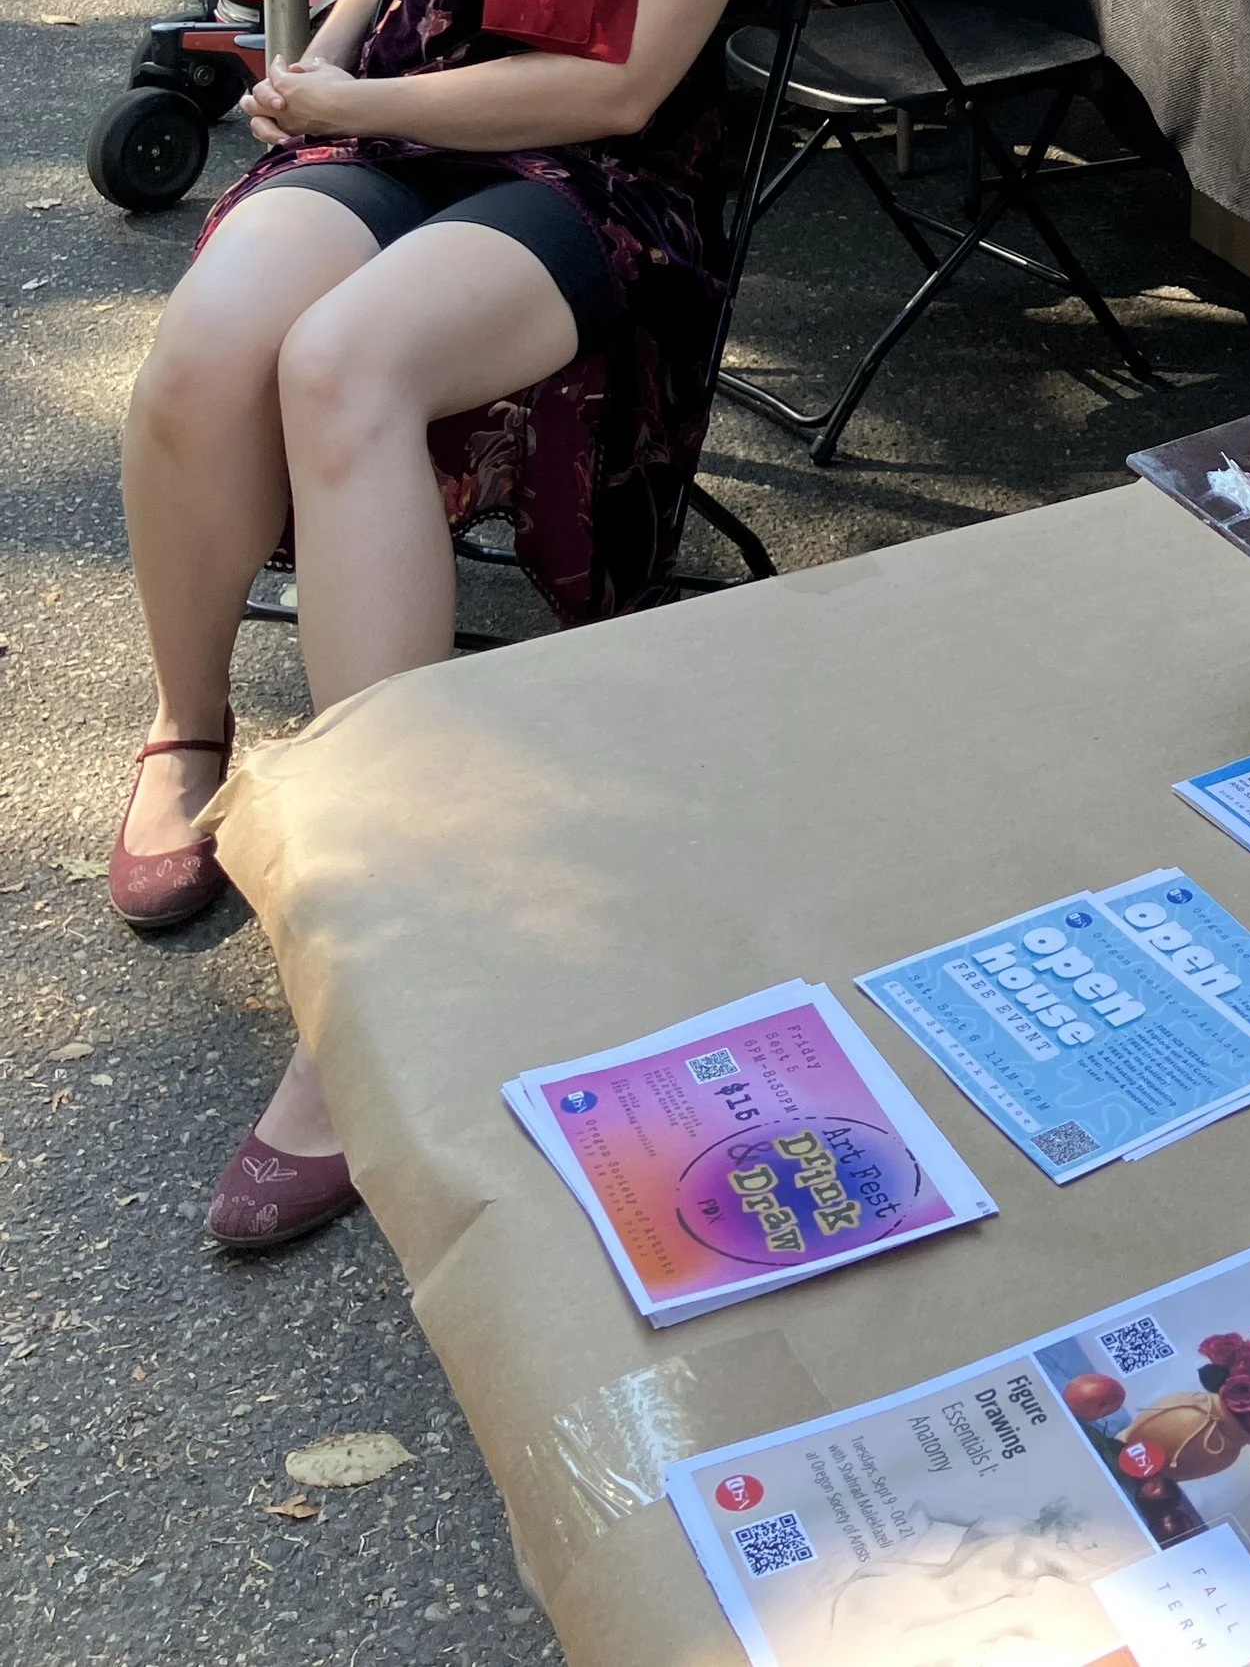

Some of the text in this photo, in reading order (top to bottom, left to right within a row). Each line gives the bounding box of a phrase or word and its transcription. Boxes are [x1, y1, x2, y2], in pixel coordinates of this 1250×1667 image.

[907, 974, 938, 999] Sat.
[933, 1003, 969, 1031] Sept
[967, 1033, 981, 1042] 6
[951, 962, 1052, 1052] FREE EVENT
[969, 941, 1110, 1048] house
[1005, 923, 1152, 1030] open
[1089, 932, 1134, 966] Oregon
[1181, 1007, 1199, 1019] of
[761, 1031, 800, 1073] Sept 5
[782, 1024, 825, 1071] Friday
[1155, 1024, 1174, 1037] FREE
[1171, 1037, 1185, 1047] ICE
[711, 1079, 767, 1124] $15
[581, 1118, 613, 1158] Oregon
[603, 1160, 638, 1206] Society
[631, 1209, 648, 1223] of
[724, 1136, 777, 1166] &
[773, 1130, 870, 1232] Drink
[822, 1124, 904, 1219] Art Fest
[696, 1197, 726, 1225] PDX
[729, 1165, 814, 1257] Draw
[940, 1401, 994, 1465] Essentials
[967, 1388, 1030, 1459] Drawing
[999, 1374, 1053, 1427] Figure
[826, 1442, 847, 1464] with
[837, 1462, 867, 1500] Shahrad
[901, 1413, 958, 1474] Anatomy
[803, 1450, 873, 1563] at Oregon Society of Artists
[845, 1435, 916, 1538] Tuesdays, Sept 9 Oct 21
[1155, 1582, 1207, 1649] TERM
[1191, 1567, 1241, 1632] FALL
